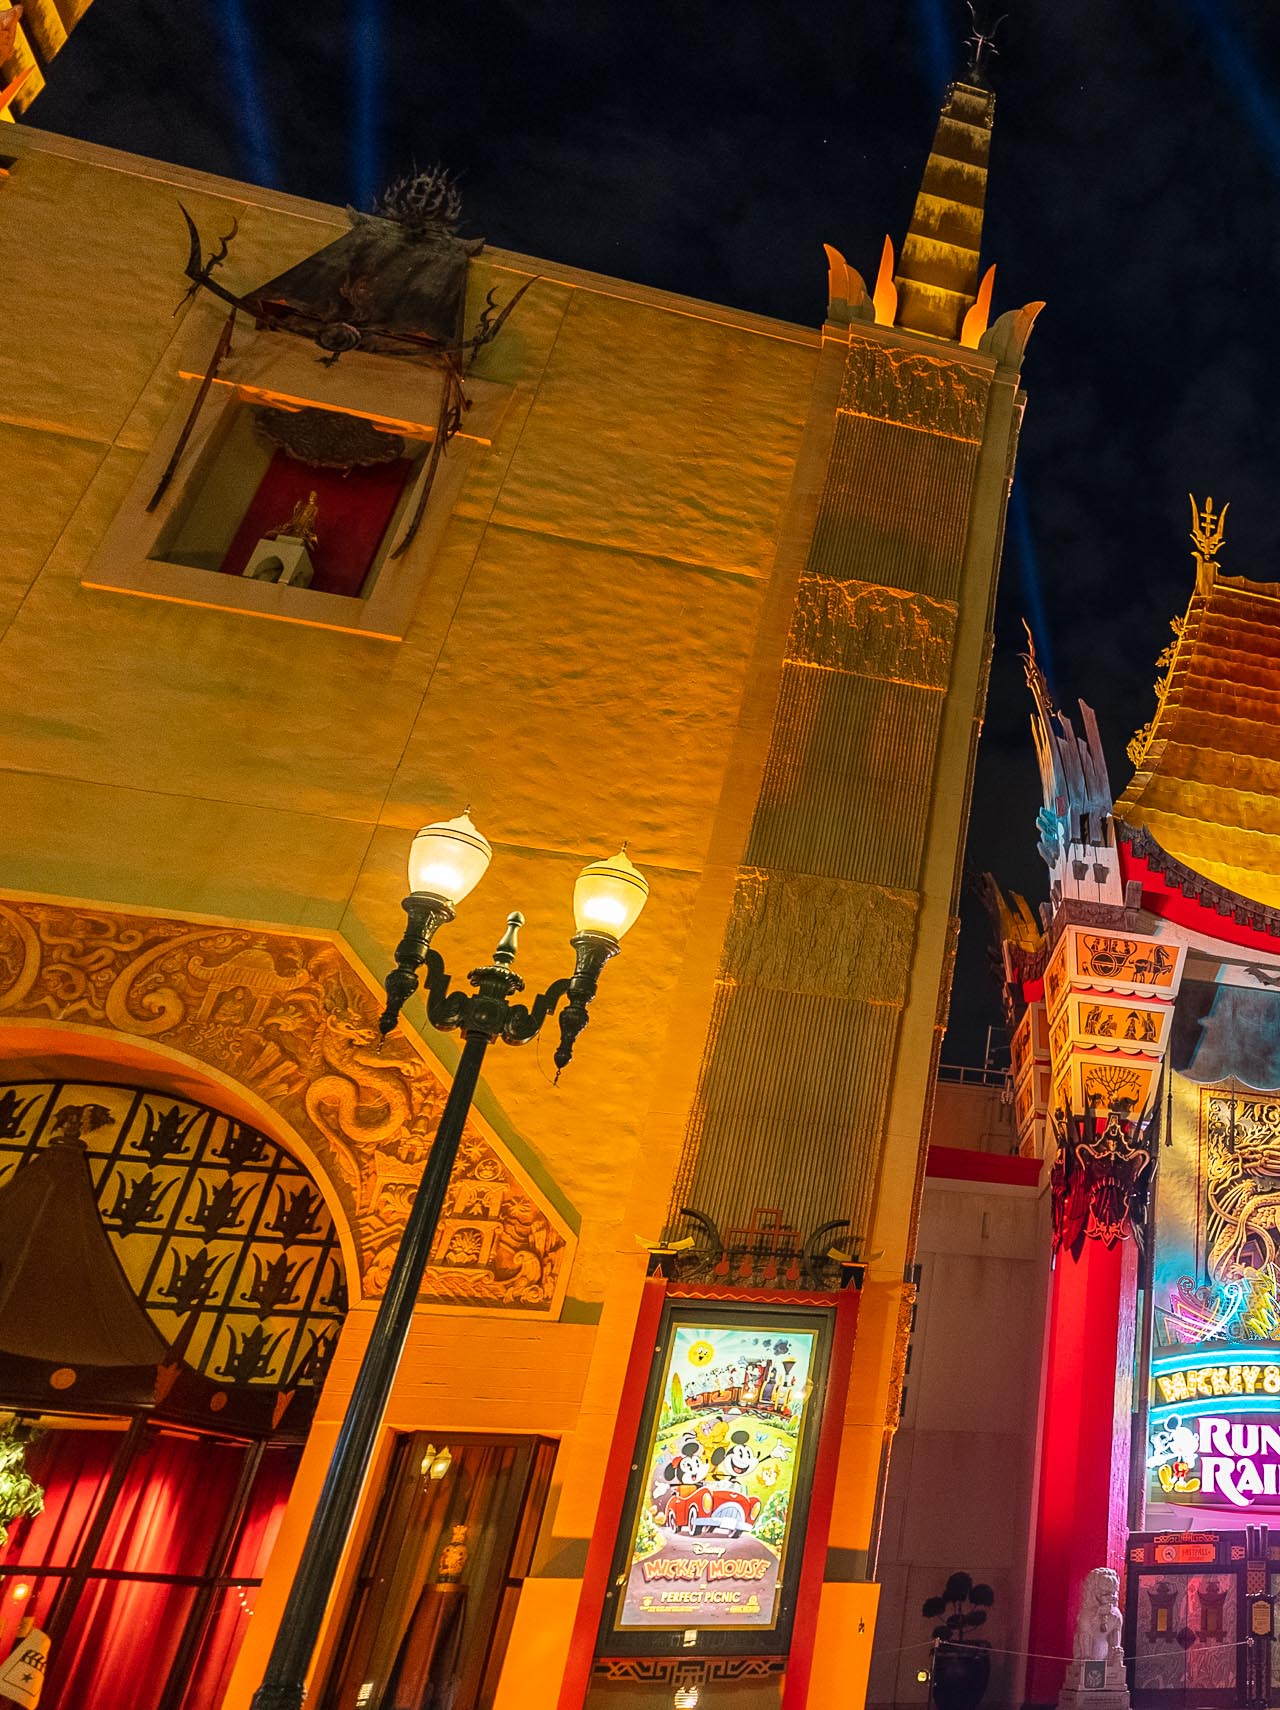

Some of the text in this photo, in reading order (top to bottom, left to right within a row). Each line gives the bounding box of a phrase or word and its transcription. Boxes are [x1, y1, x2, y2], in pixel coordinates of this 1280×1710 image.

[1157, 1366, 1260, 1402] MICKEY
[691, 1542, 727, 1557] Disney
[643, 1558, 771, 1583] MICKEY MOUSE
[661, 1591, 742, 1604] PERFECT PICNIC
